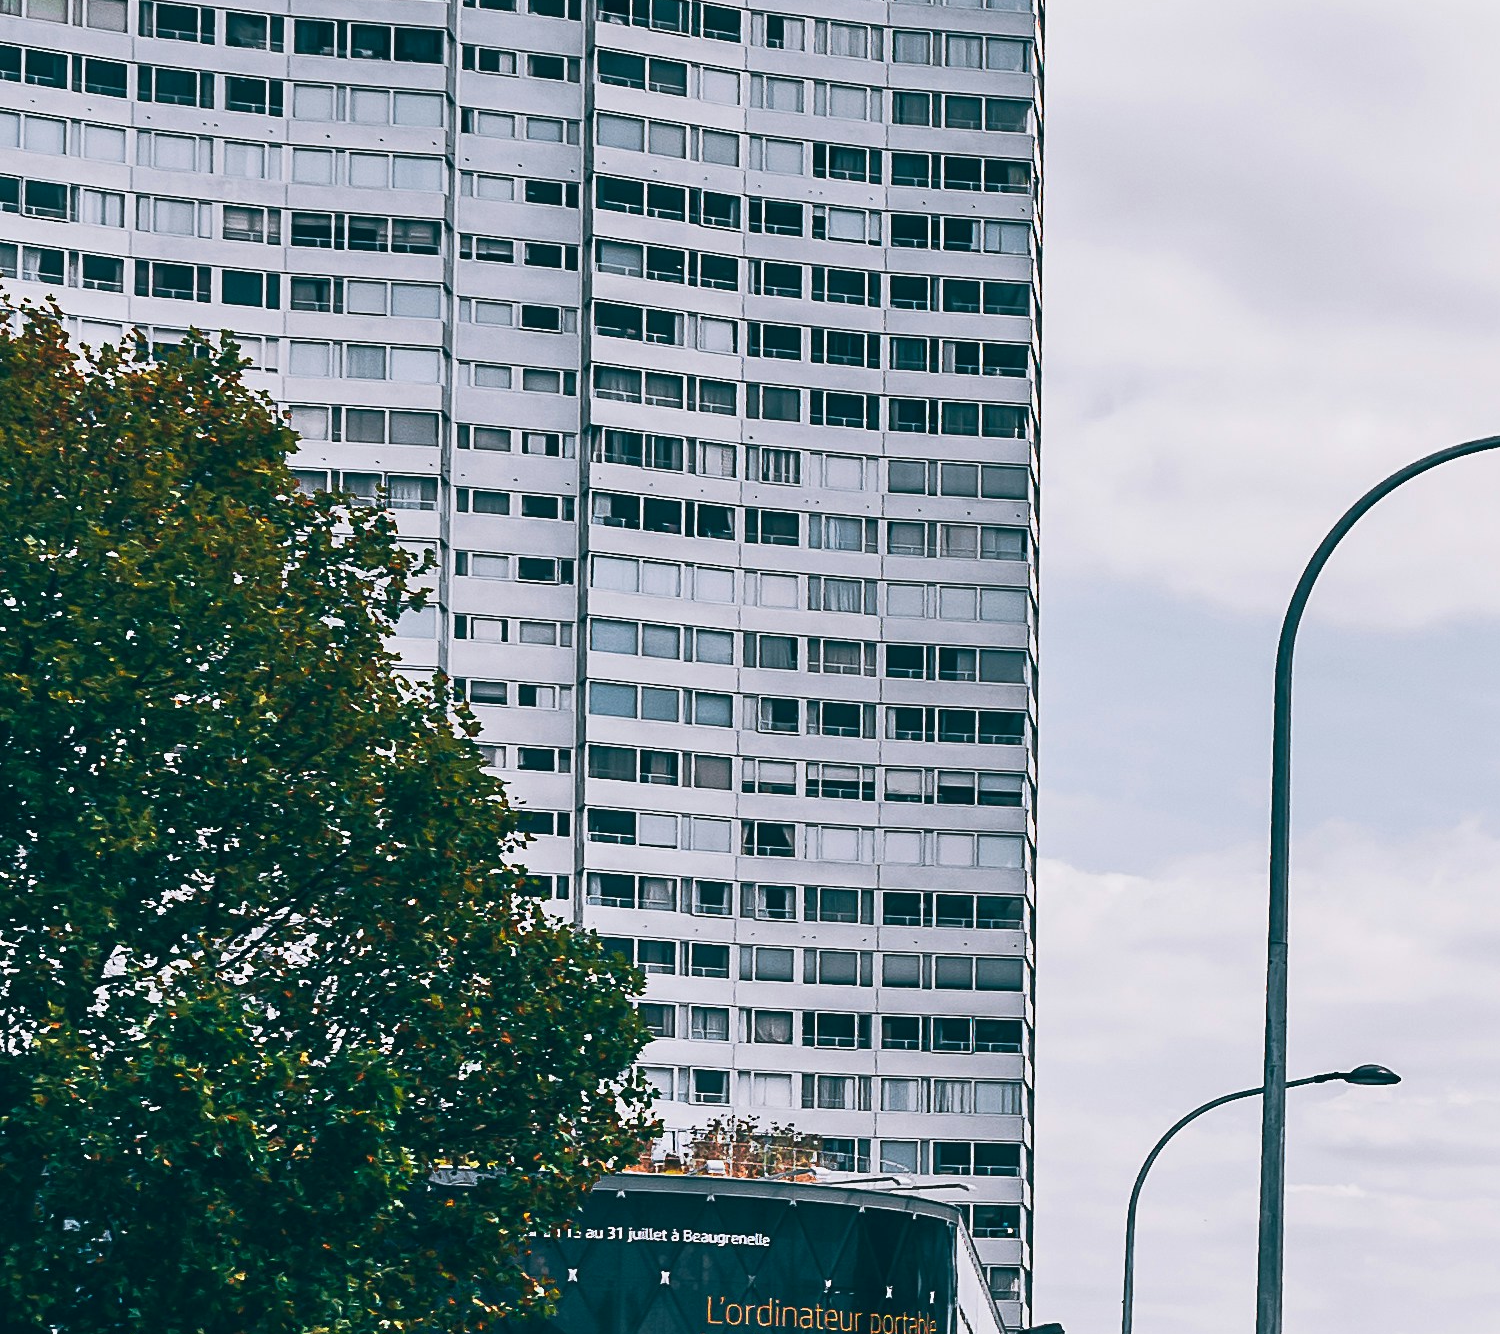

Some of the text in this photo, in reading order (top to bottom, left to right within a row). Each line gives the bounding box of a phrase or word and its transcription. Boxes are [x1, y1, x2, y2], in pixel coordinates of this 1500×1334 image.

[586, 1227, 604, 1239] au
[607, 1226, 624, 1240] 31
[627, 1227, 668, 1243] juillet
[671, 1229, 679, 1242] à
[683, 1230, 771, 1247] Beaugrenelle
[707, 1296, 862, 1332] L'ordinateur
